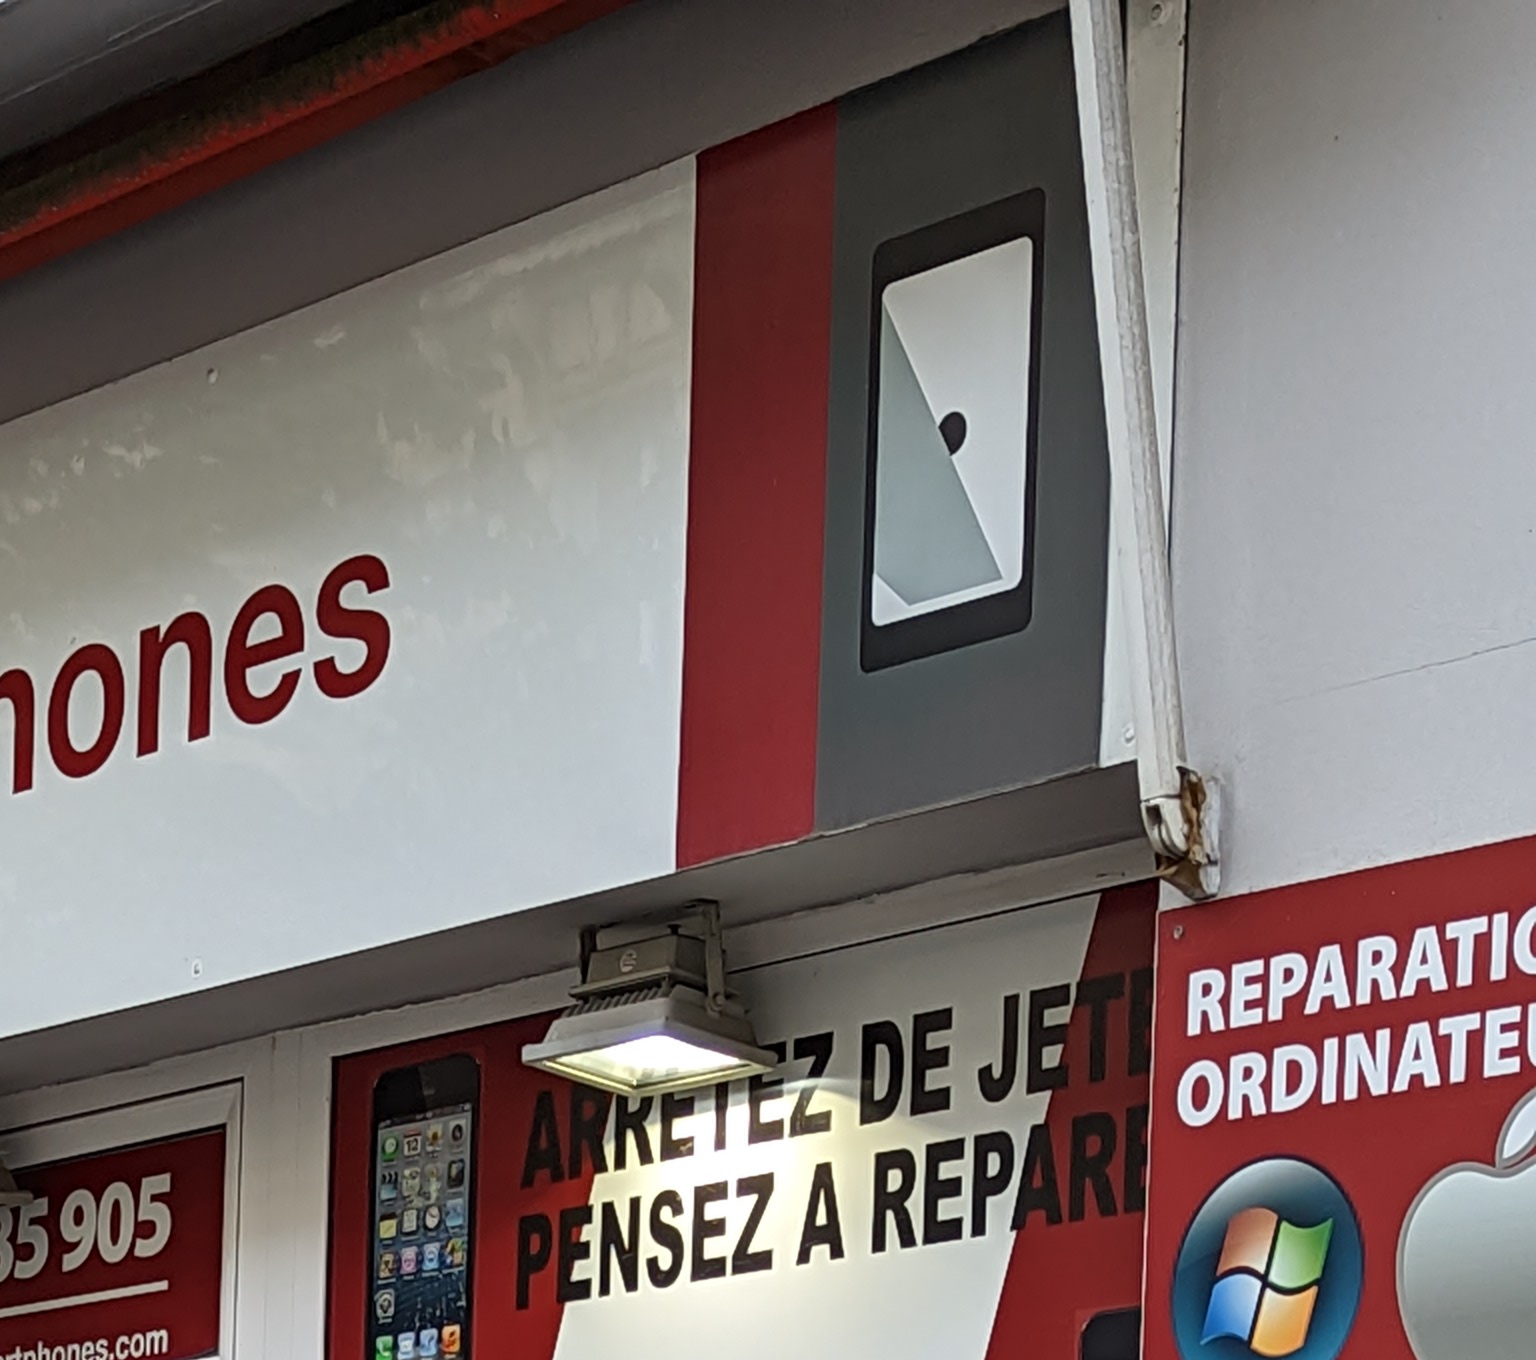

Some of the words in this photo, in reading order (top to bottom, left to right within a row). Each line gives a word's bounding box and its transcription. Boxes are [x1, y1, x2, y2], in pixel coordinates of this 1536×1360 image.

[860, 1006, 953, 1126] DE
[1176, 1002, 1536, 1128] ORDINATE
[60, 1171, 172, 1274] 905
[517, 1170, 774, 1310] PENSEZ
[797, 1162, 844, 1267] A
